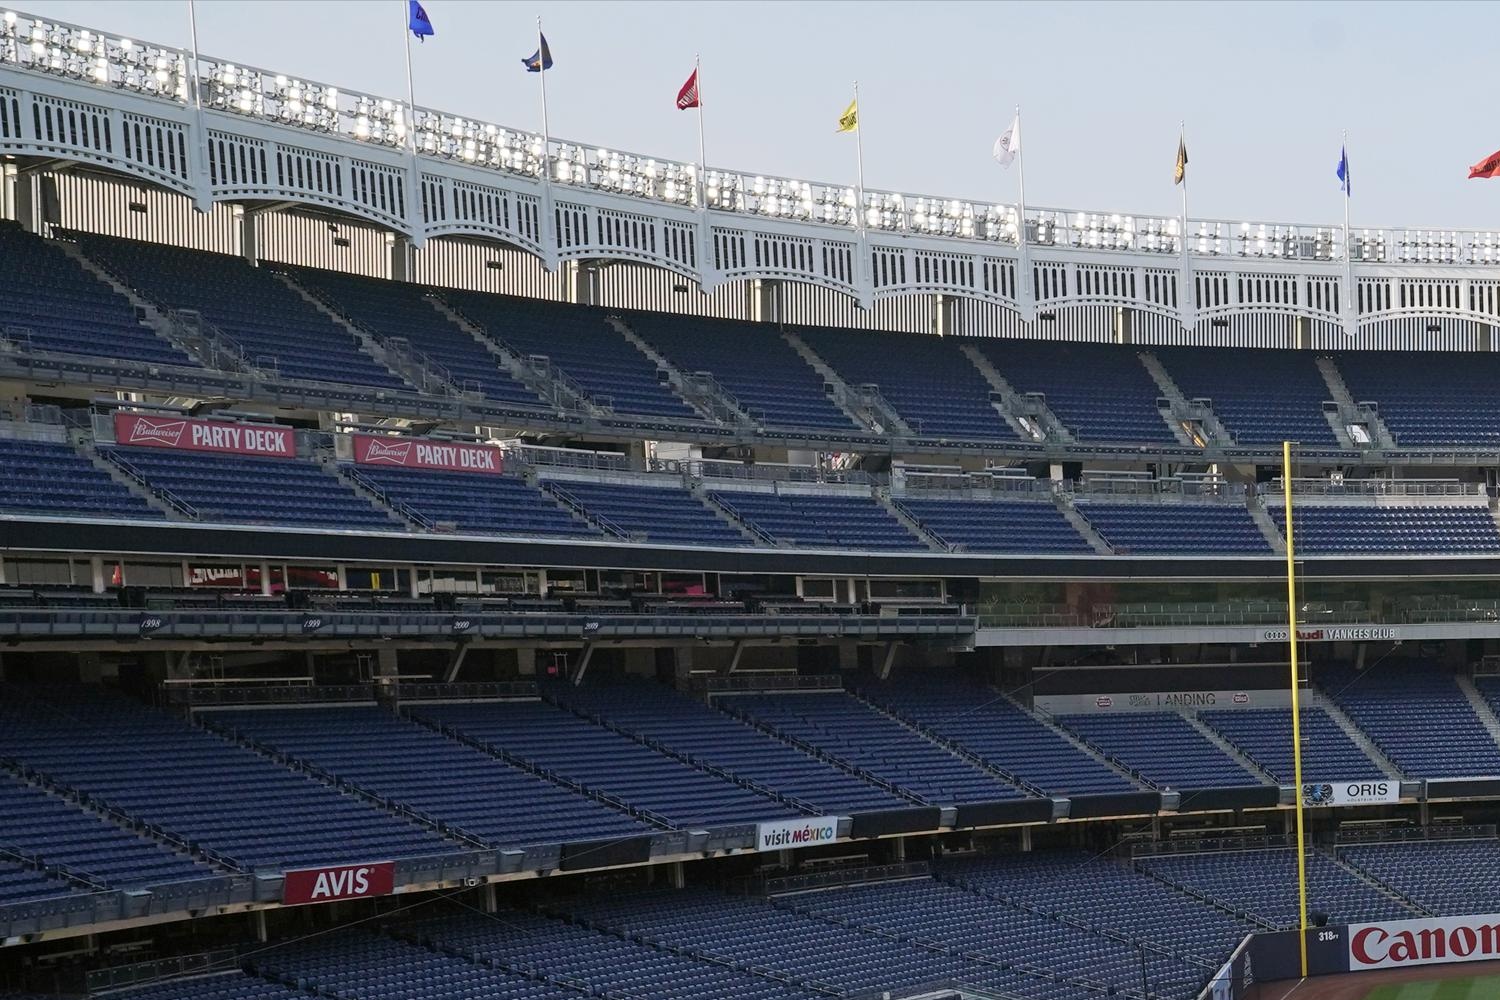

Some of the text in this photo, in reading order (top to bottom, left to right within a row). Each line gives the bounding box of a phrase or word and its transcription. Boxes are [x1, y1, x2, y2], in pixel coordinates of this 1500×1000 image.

[135, 424, 286, 452] Budweiser PARTY DECK
[369, 444, 494, 469] Budweiser PARTY DECK
[141, 619, 162, 628] 1998
[304, 620, 321, 628] 1999
[1328, 629, 1370, 639] YANKEES
[1372, 629, 1396, 639] CLUB
[1347, 783, 1388, 797] ORIS
[764, 829, 790, 846] visit
[311, 867, 370, 899] AVIS
